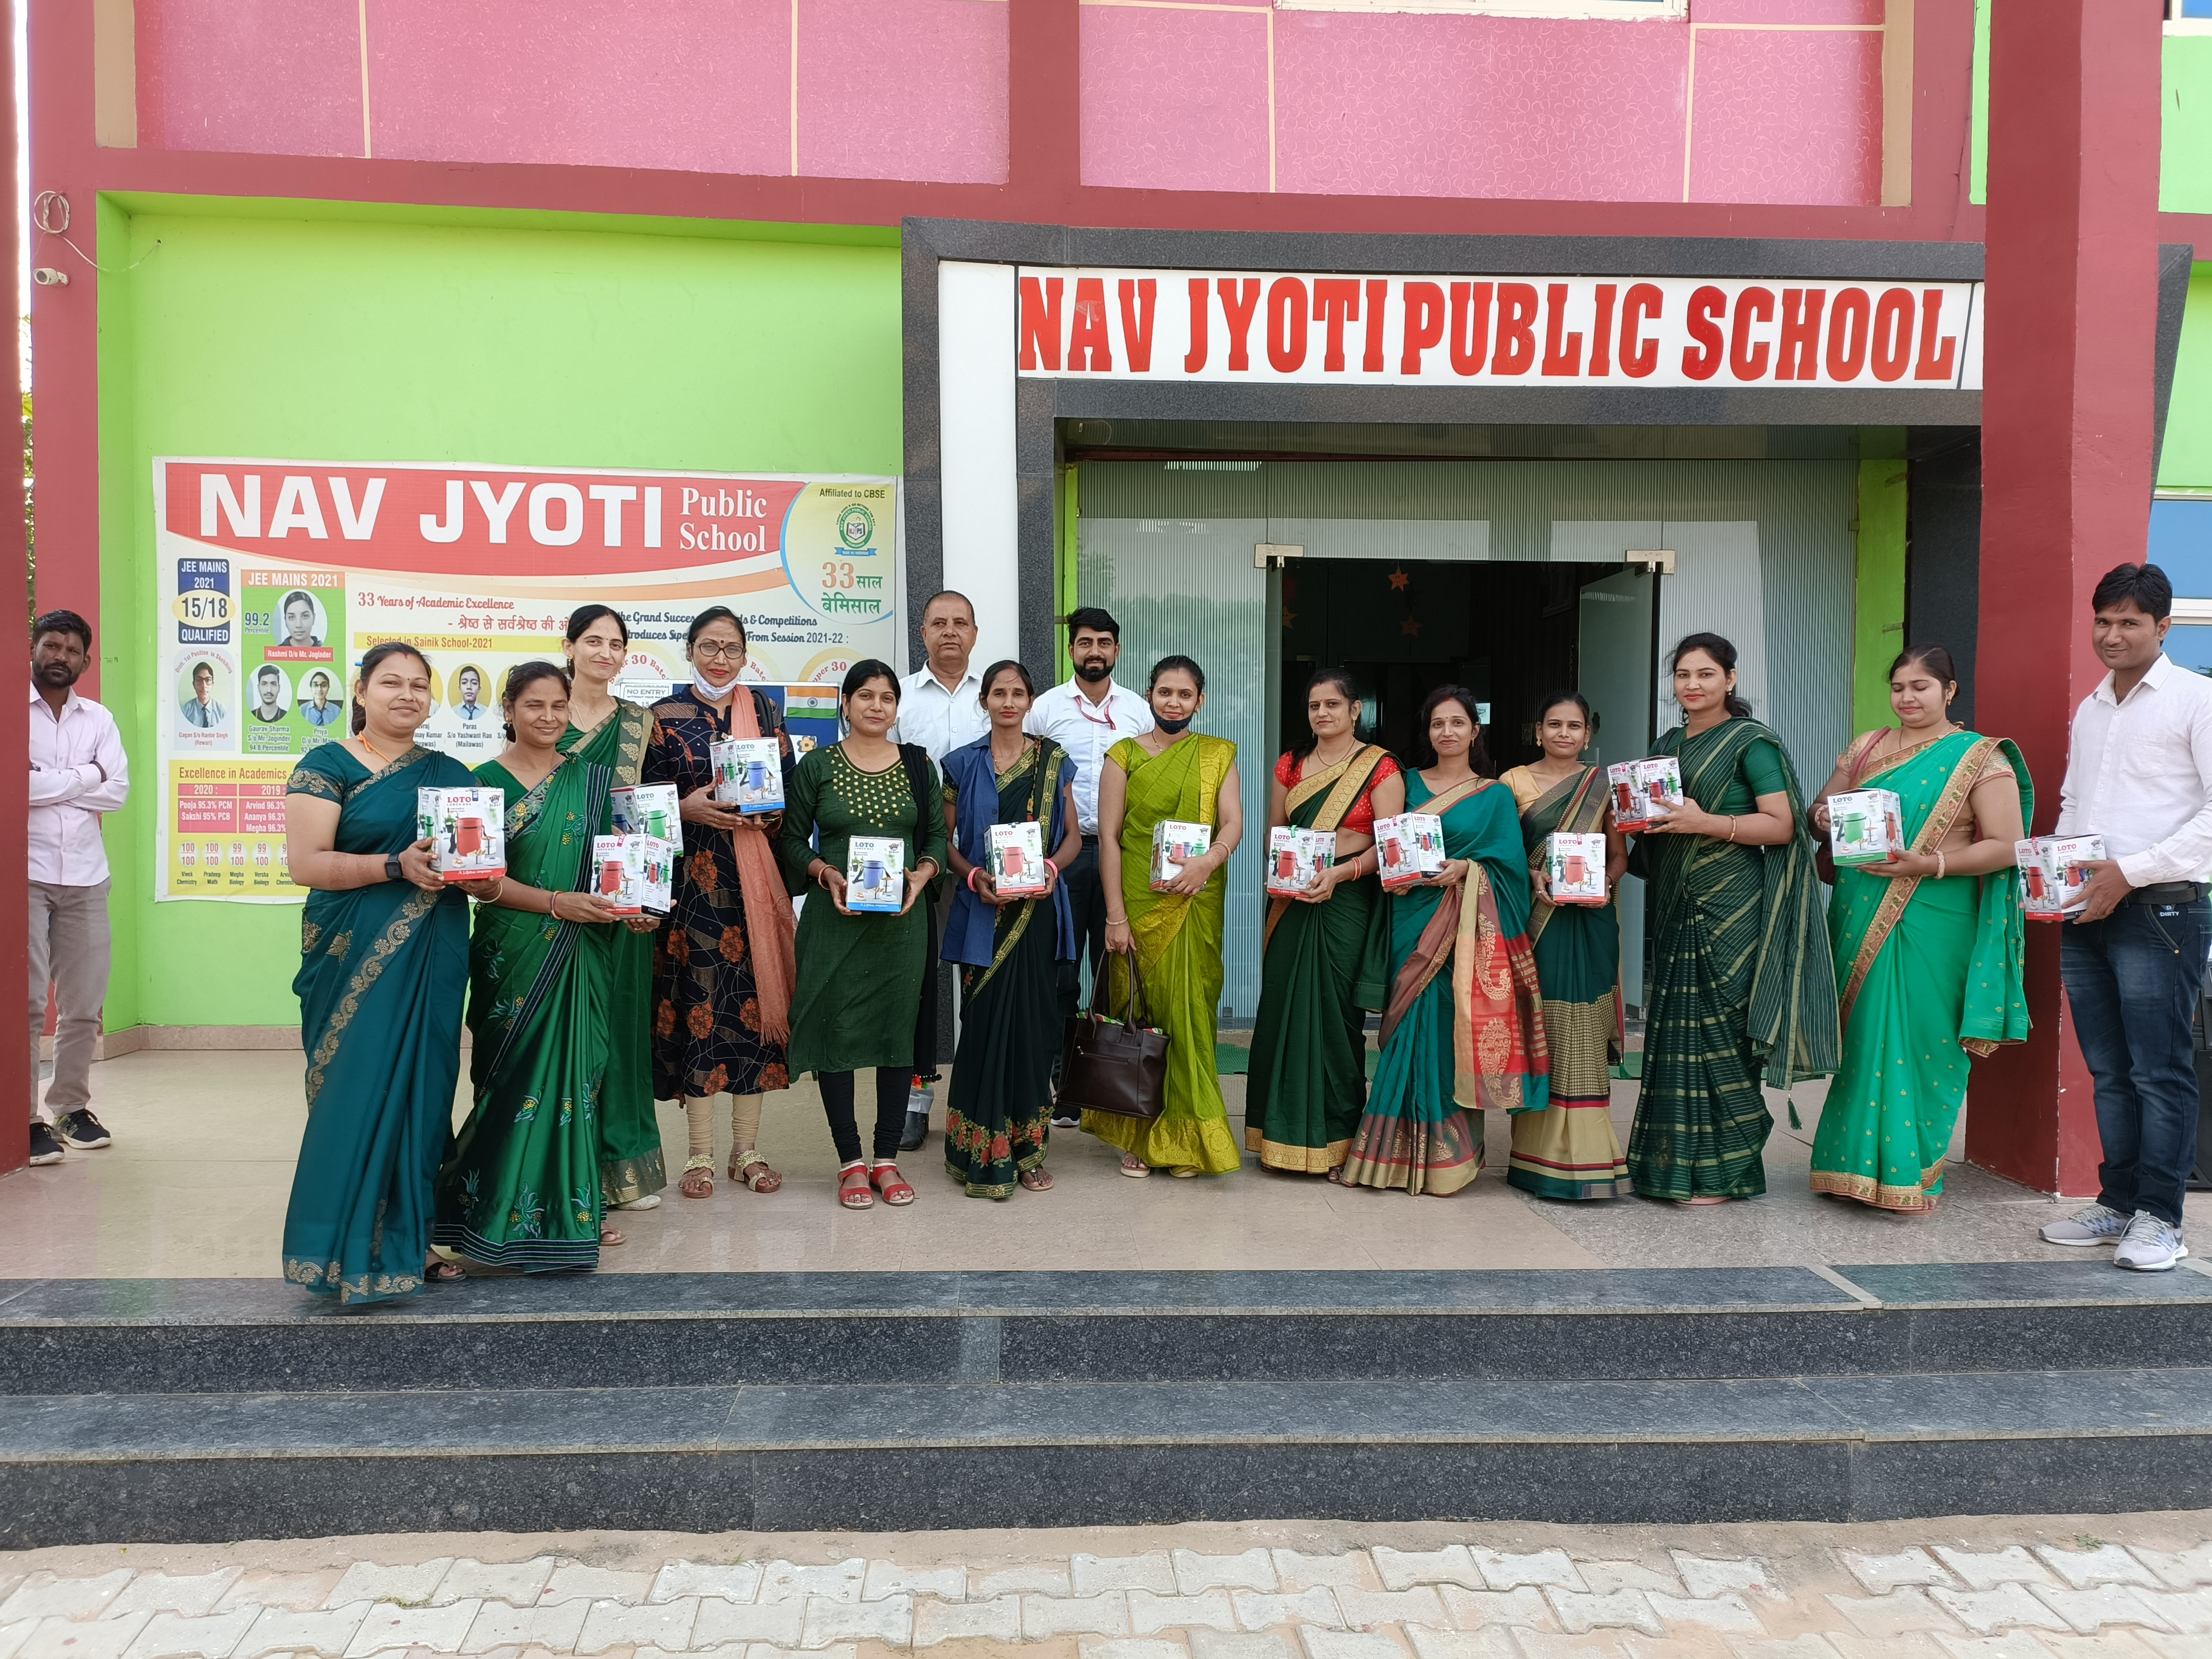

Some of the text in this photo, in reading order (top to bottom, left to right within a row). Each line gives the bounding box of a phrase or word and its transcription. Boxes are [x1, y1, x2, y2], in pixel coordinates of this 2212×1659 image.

[1019, 276, 1957, 382] NAV JYOTI PUBLIC SCHOOL
[819, 488, 852, 497] Affiliated
[864, 490, 885, 498] CBSE
[680, 487, 767, 518] Public
[200, 474, 662, 547] NAV JYOTI
[680, 522, 766, 552] School
[181, 561, 227, 573] JEE MAINS
[248, 573, 338, 586] JEE MAINS 2021
[822, 562, 854, 588] 33
[194, 577, 214, 589] 2021
[856, 575, 883, 589] साल
[358, 592, 514, 610] 33 Years of Academic Excellence
[821, 592, 881, 614] बेमिसाल
[181, 597, 227, 620] 15/18
[245, 612, 269, 626] 99.2
[457, 614, 480, 630] श्रेष्ठ
[483, 615, 494, 630] से
[540, 616, 555, 631] की
[633, 611, 662, 625] Grand
[750, 615, 757, 624] &
[758, 614, 818, 628] Competitions
[181, 629, 229, 641] QUALIFIED
[746, 631, 843, 643] From Session 2021-22
[404, 637, 411, 645] in
[414, 637, 439, 647] Sainik
[442, 637, 492, 648] School-2021
[289, 650, 298, 658] D/o
[309, 651, 332, 660] Joginder
[215, 653, 233, 674] Sketching
[631, 655, 669, 679] 30 Batc
[831, 662, 847, 671] 30
[750, 662, 769, 681] Batc
[179, 767, 287, 779] Excellence in Academics
[194, 785, 213, 795] 2020
[262, 785, 281, 795] 2019
[179, 801, 232, 810] Pooja 95.3% PCM
[245, 801, 286, 810] Arvind 96.3%
[181, 812, 231, 820] Sakshi 95% PCB
[244, 812, 286, 822] Ananya 96.3%
[246, 824, 287, 834] Megha 96.3%
[182, 843, 195, 852] 100
[206, 843, 219, 852] 100
[233, 843, 242, 852] 99
[257, 843, 266, 852] 99
[647, 840, 659, 848] LOTO
[182, 856, 195, 865] 100
[206, 856, 219, 865] 100
[231, 857, 243, 865] 100
[255, 857, 268, 865] 100
